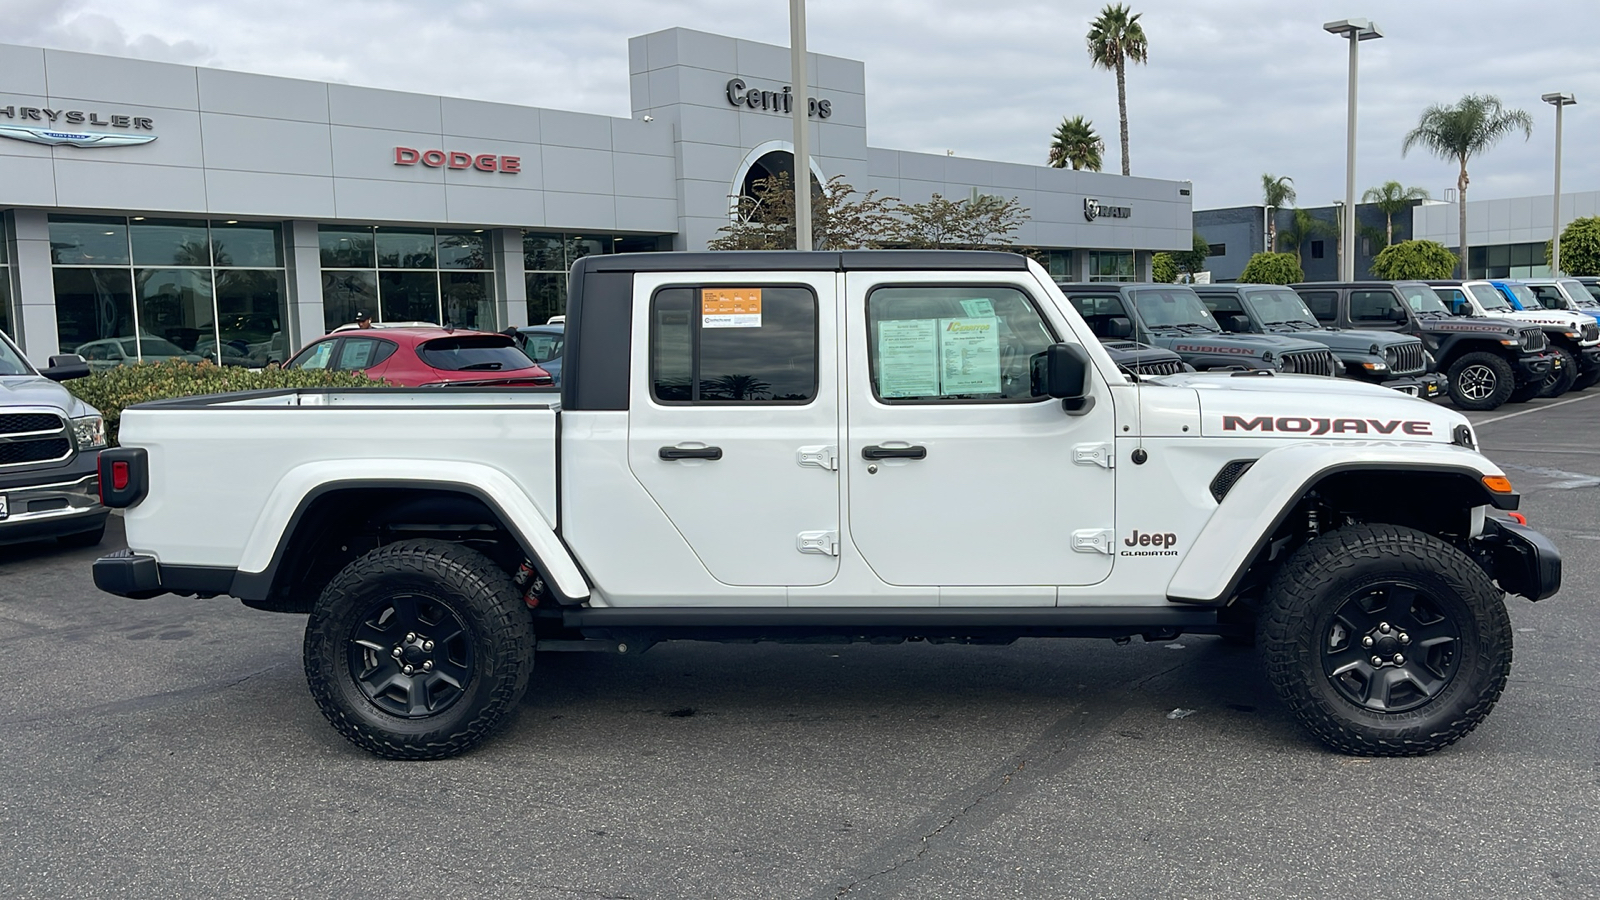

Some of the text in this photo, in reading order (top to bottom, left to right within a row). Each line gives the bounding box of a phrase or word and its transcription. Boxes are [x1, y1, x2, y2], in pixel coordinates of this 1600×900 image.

[726, 78, 832, 118] Cerrios
[0, 106, 154, 130] HRYSLER
[393, 146, 521, 174] DODGE
[1098, 205, 1131, 218] RAM
[1176, 345, 1255, 355] RUBICON
[1222, 415, 1434, 436] MOJAVE
[1124, 529, 1177, 550] Jeep
